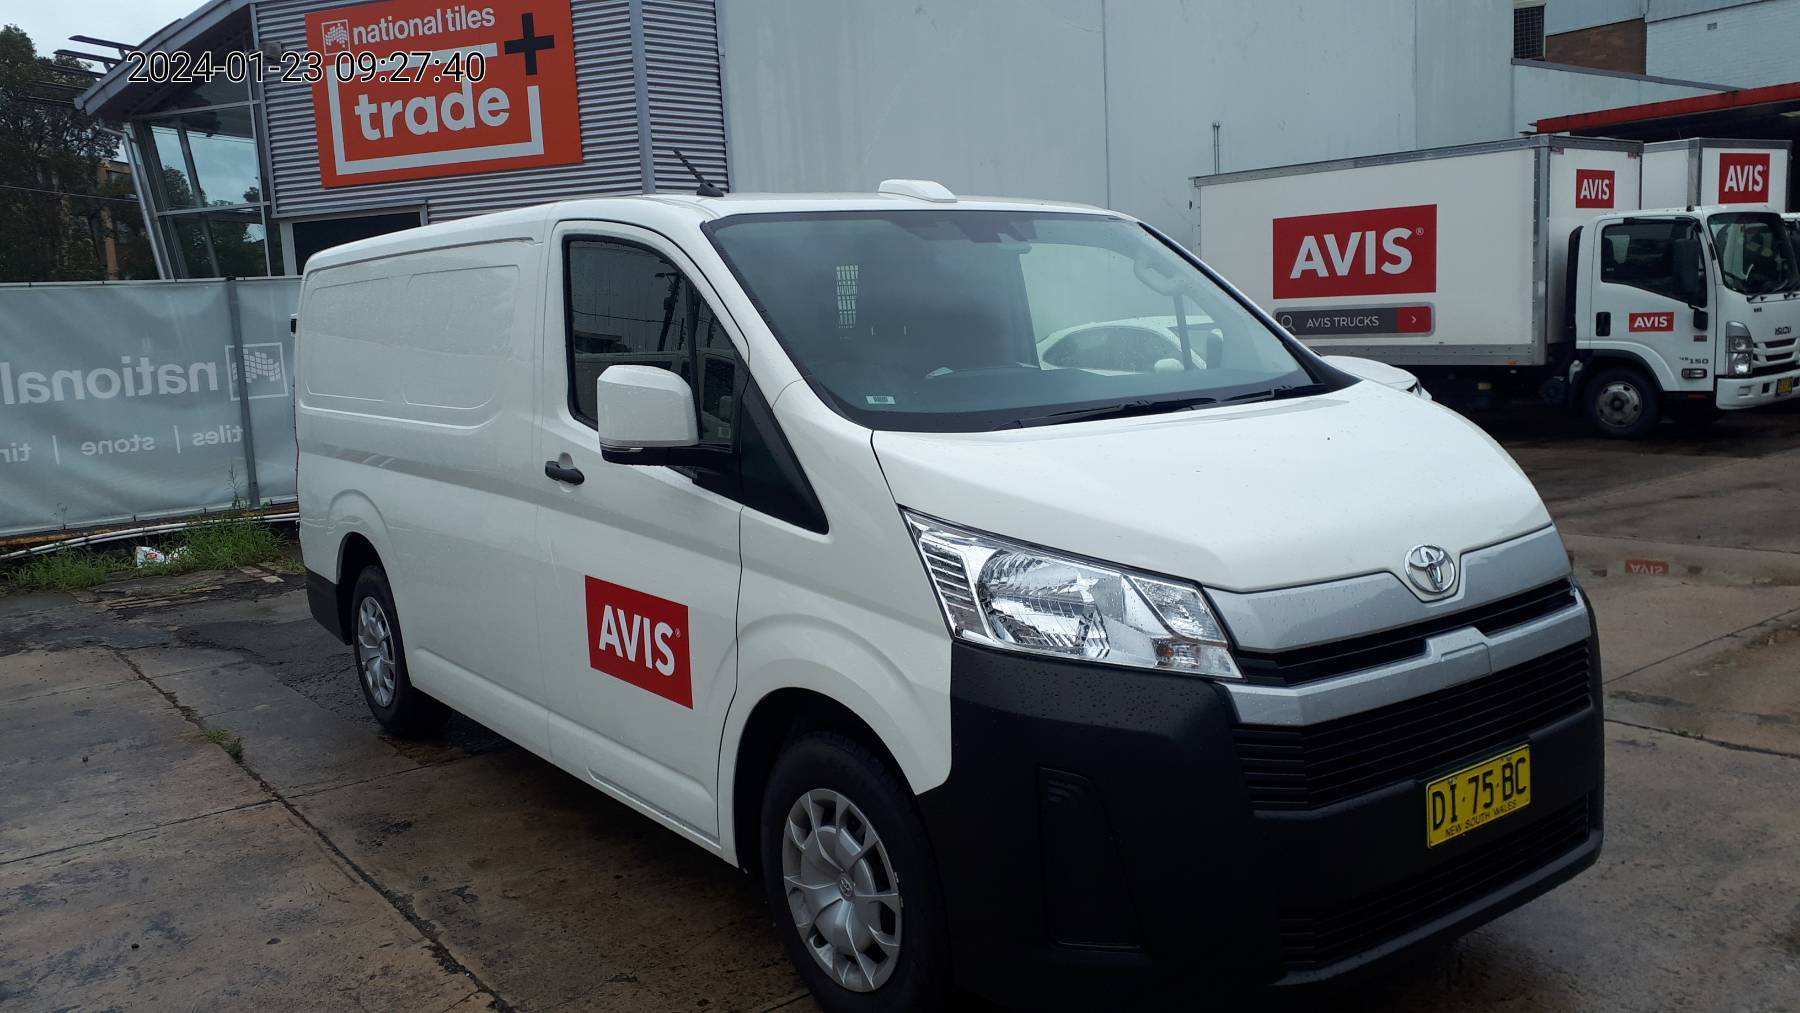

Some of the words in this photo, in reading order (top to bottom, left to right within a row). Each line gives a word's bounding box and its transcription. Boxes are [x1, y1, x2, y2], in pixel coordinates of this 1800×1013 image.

[353, 8, 443, 45] national
[445, 7, 496, 33] tiles
[354, 78, 510, 141] trade
[1580, 178, 1610, 200] AVIS
[1306, 318, 1331, 328] AVIS
[1333, 315, 1379, 327] TRUCKS
[1633, 316, 1668, 328] AVIS
[1445, 823, 1462, 836] NEW
[1465, 812, 1490, 829] SOUTH
[1493, 799, 1517, 816] WALES
